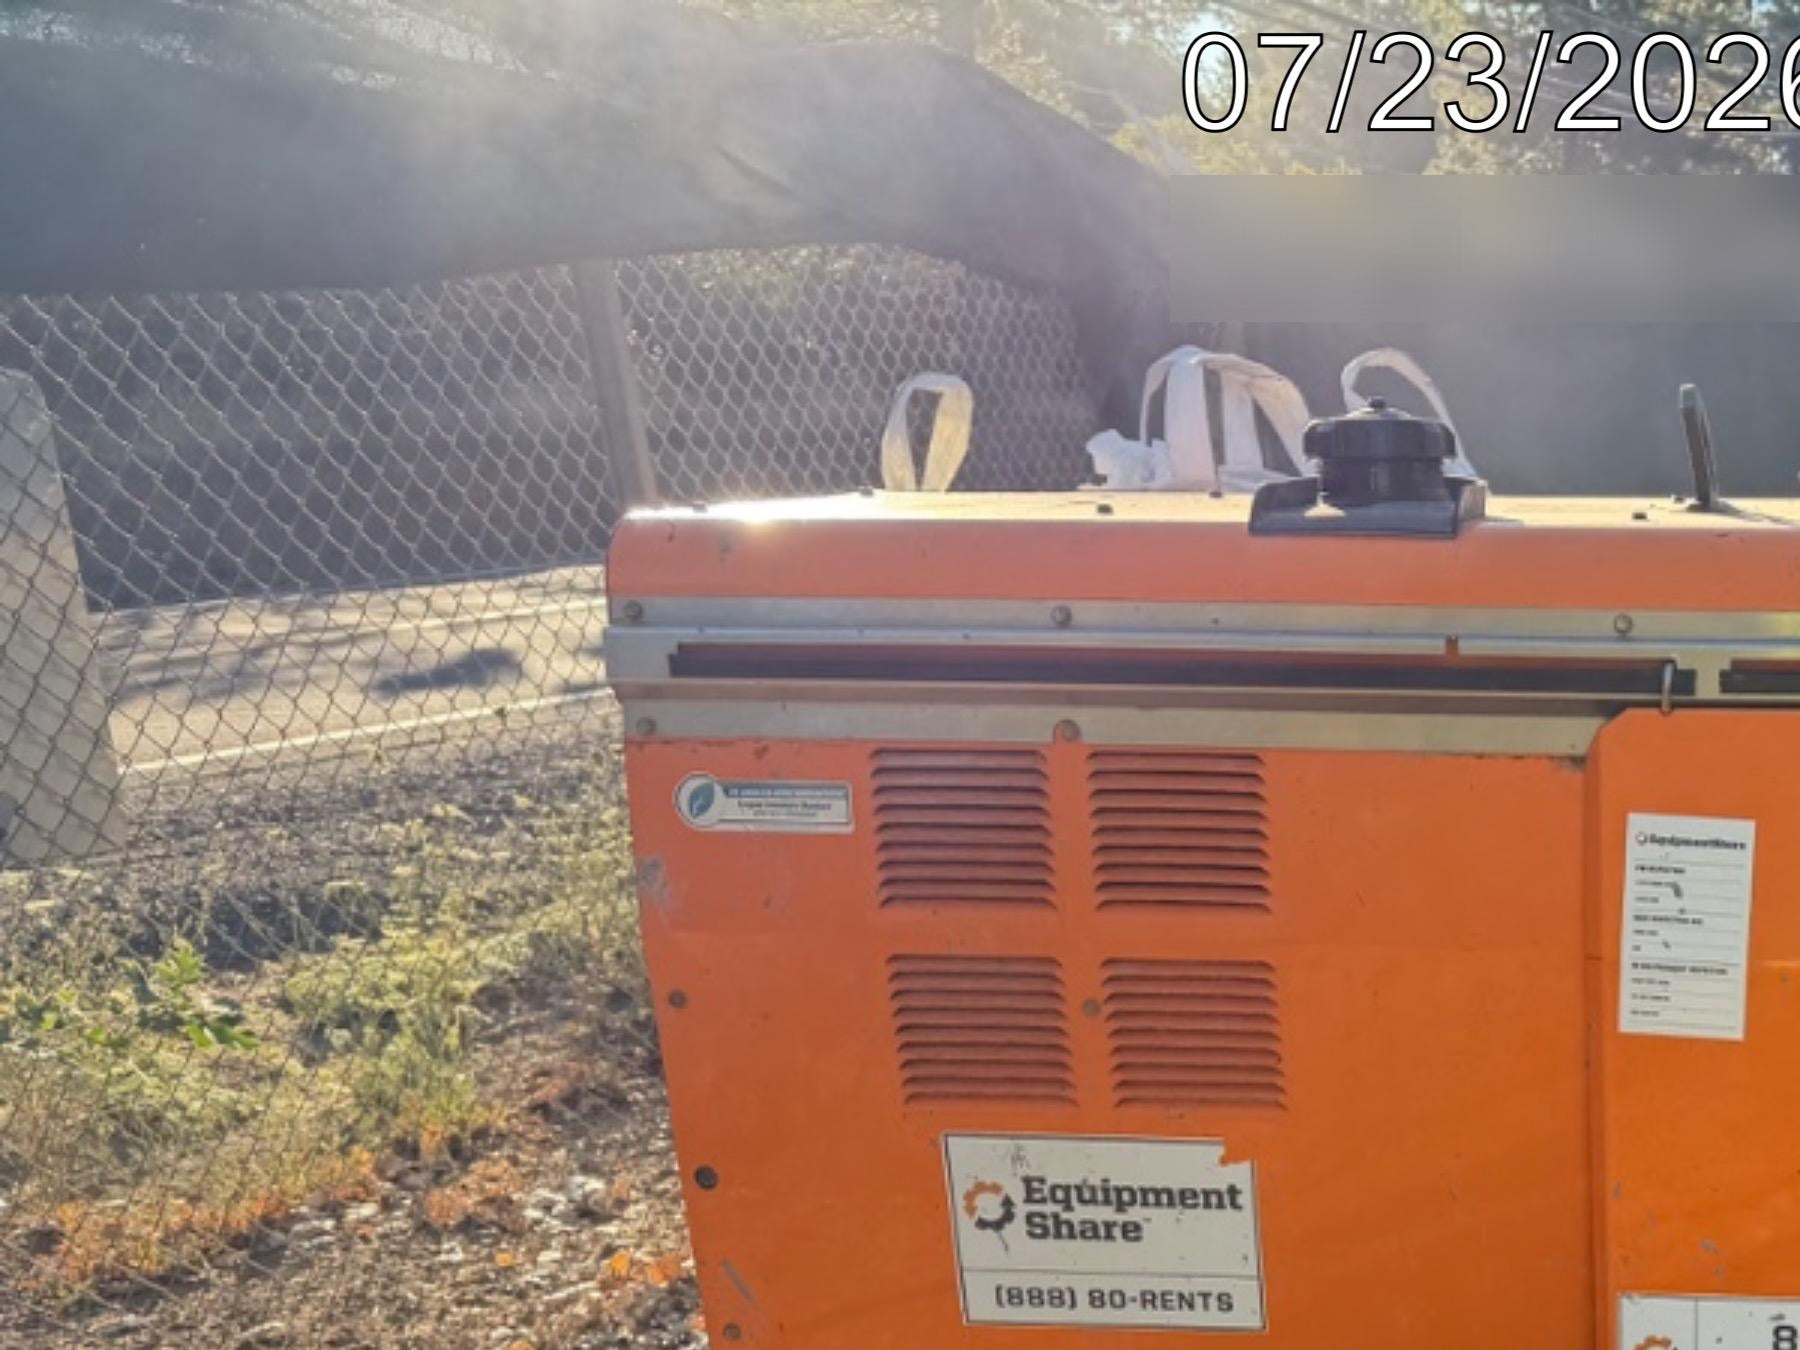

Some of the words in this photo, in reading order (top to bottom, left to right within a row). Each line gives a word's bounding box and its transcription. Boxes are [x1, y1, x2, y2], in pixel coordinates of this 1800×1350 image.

[1022, 1174, 1243, 1214] Equipment
[1024, 1212, 1144, 1243] Share
[994, 1286, 1078, 1312] (888)
[1087, 1288, 1235, 1314] 80-RENTS
